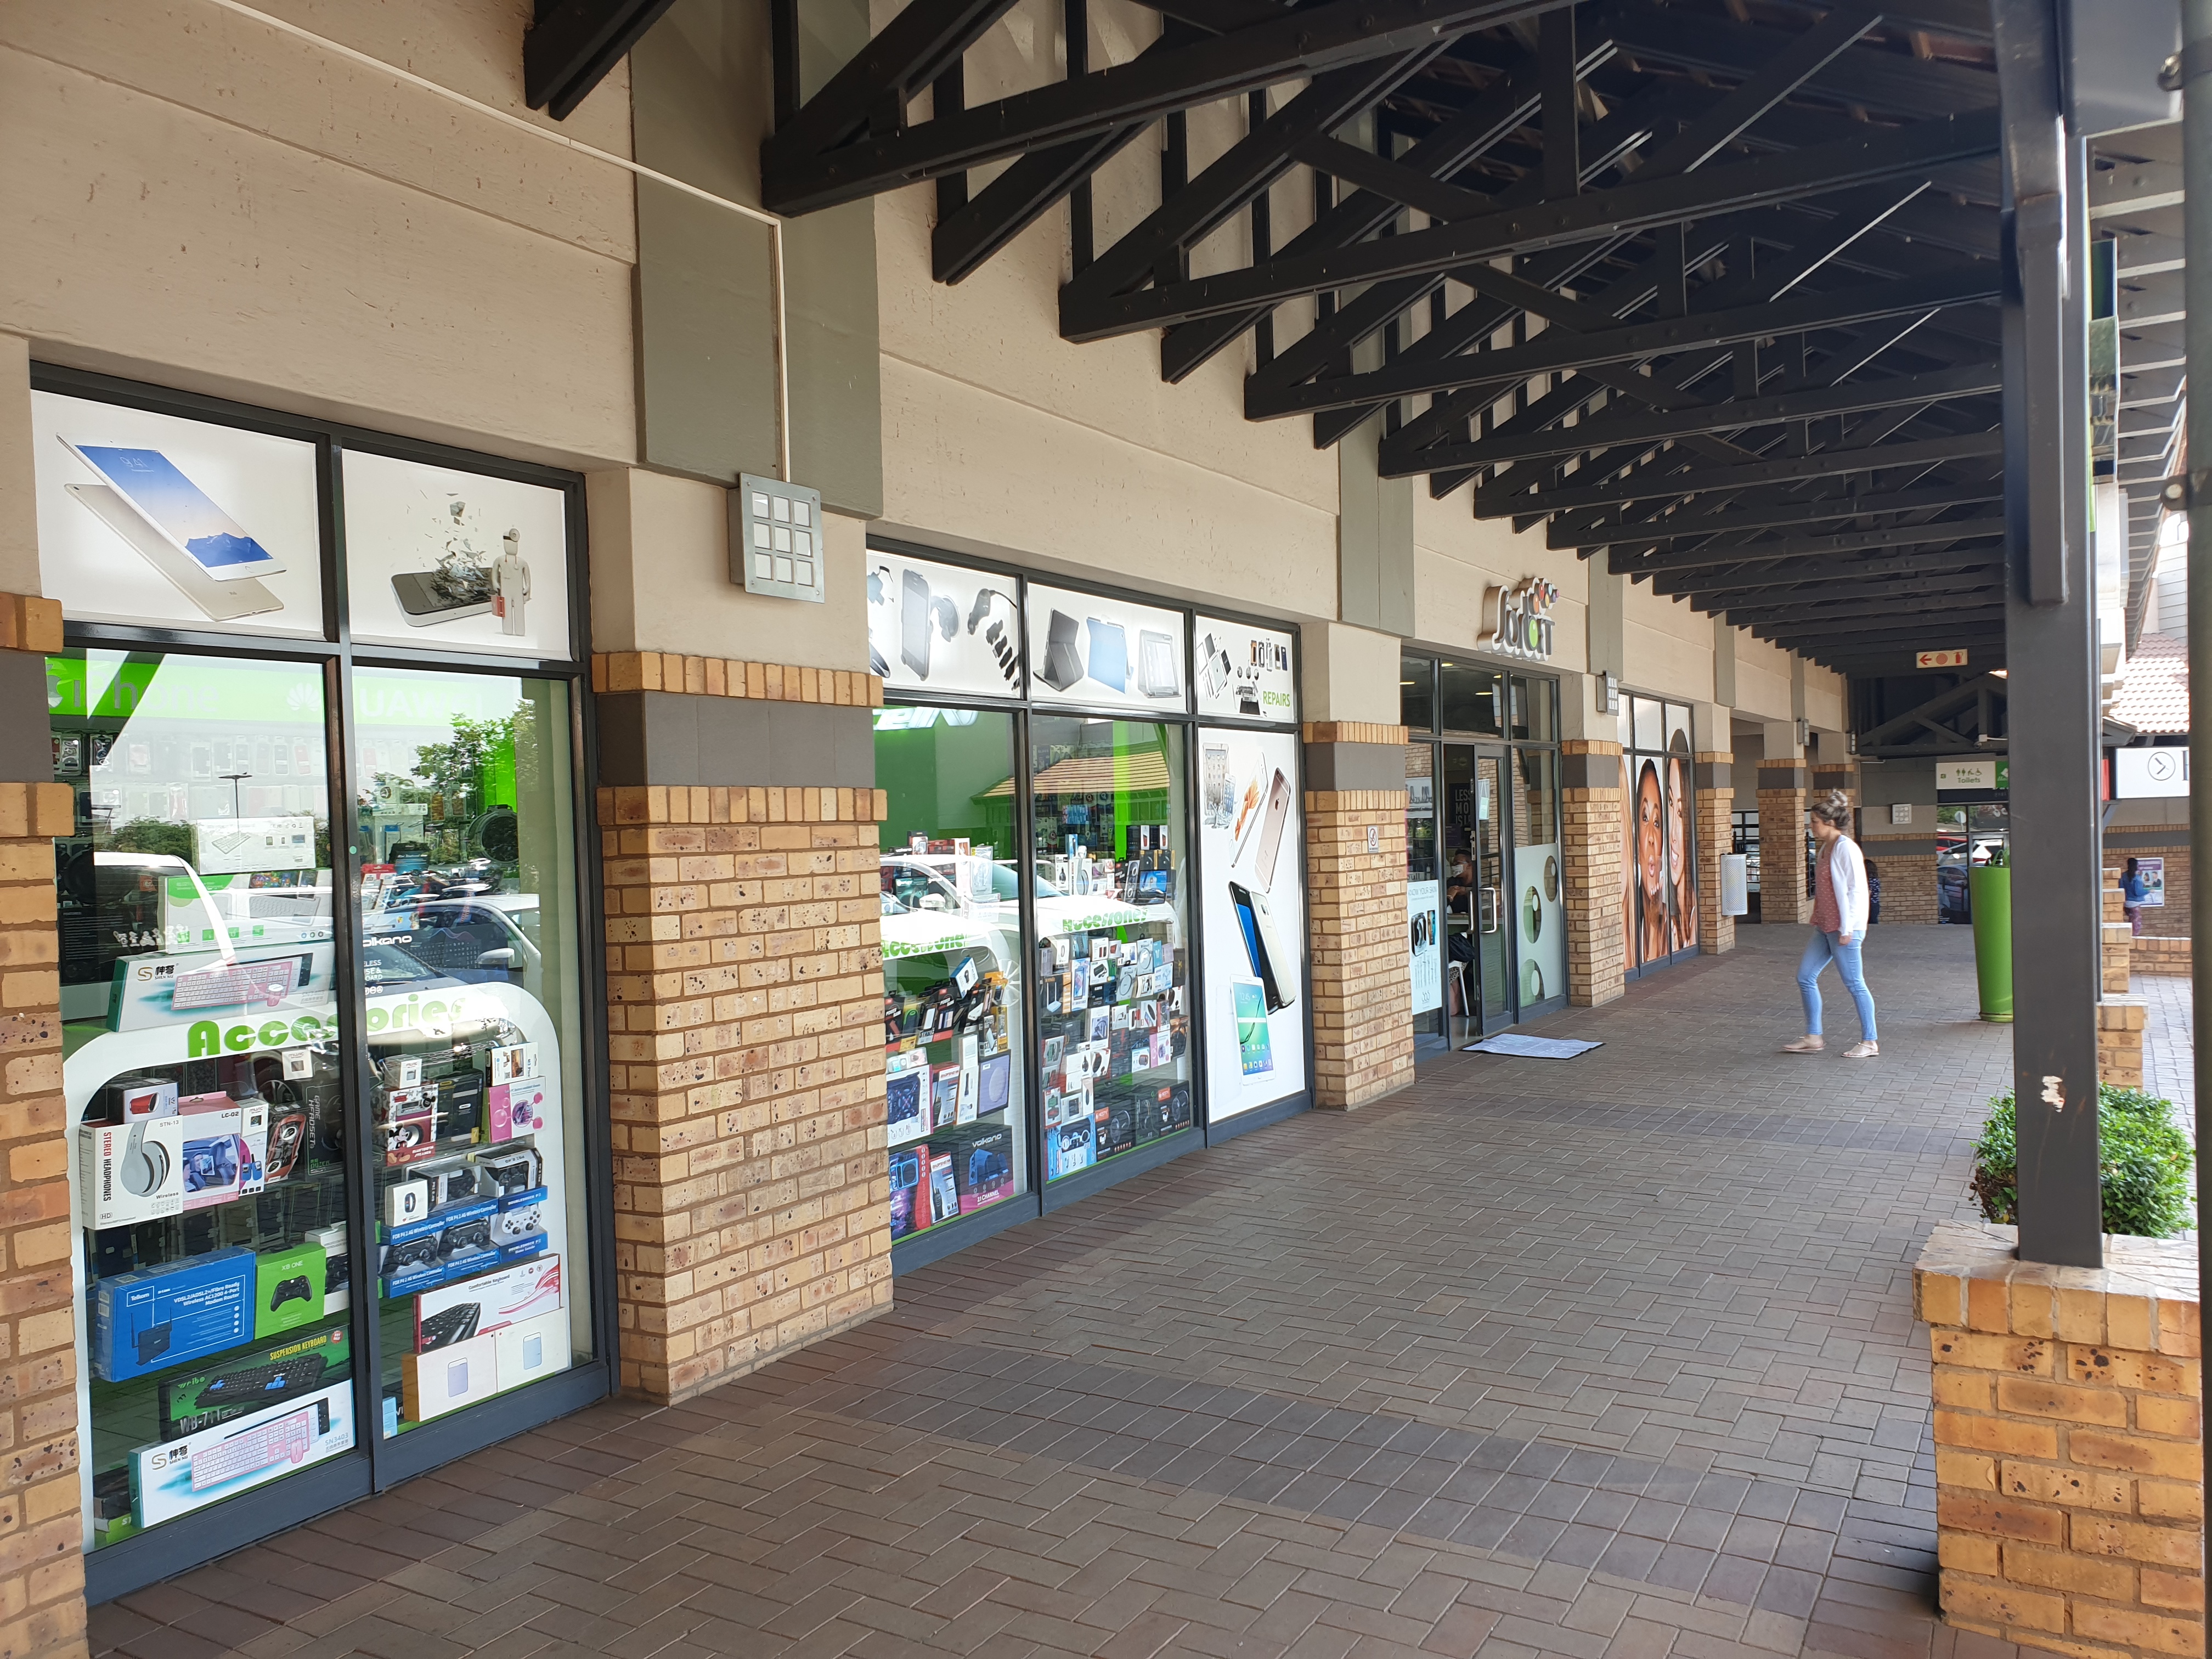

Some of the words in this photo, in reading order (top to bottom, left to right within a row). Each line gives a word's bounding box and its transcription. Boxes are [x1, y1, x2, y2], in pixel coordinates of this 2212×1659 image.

[359, 688, 483, 719] UAWEI
[1263, 691, 1290, 707] REPAIRS
[1455, 802, 1469, 814] MO
[363, 935, 413, 947] olkano
[886, 1007, 897, 1016] POWER
[188, 994, 466, 1058] Acceories
[972, 1133, 1002, 1147] volkano
[103, 1159, 111, 1201] HEADPHONES
[225, 1282, 240, 1290] Ready
[469, 1279, 492, 1289] Comfortable
[493, 1274, 510, 1283] Keyboard
[131, 1293, 150, 1301] Telkom
[183, 1297, 204, 1306] Wireless
[205, 1291, 223, 1300] AC1200
[205, 1297, 223, 1306] Modem
[270, 1344, 301, 1361] SUSPENSION
[302, 1335, 327, 1350] KEYBOARD
[325, 1432, 349, 1446] SN3403
